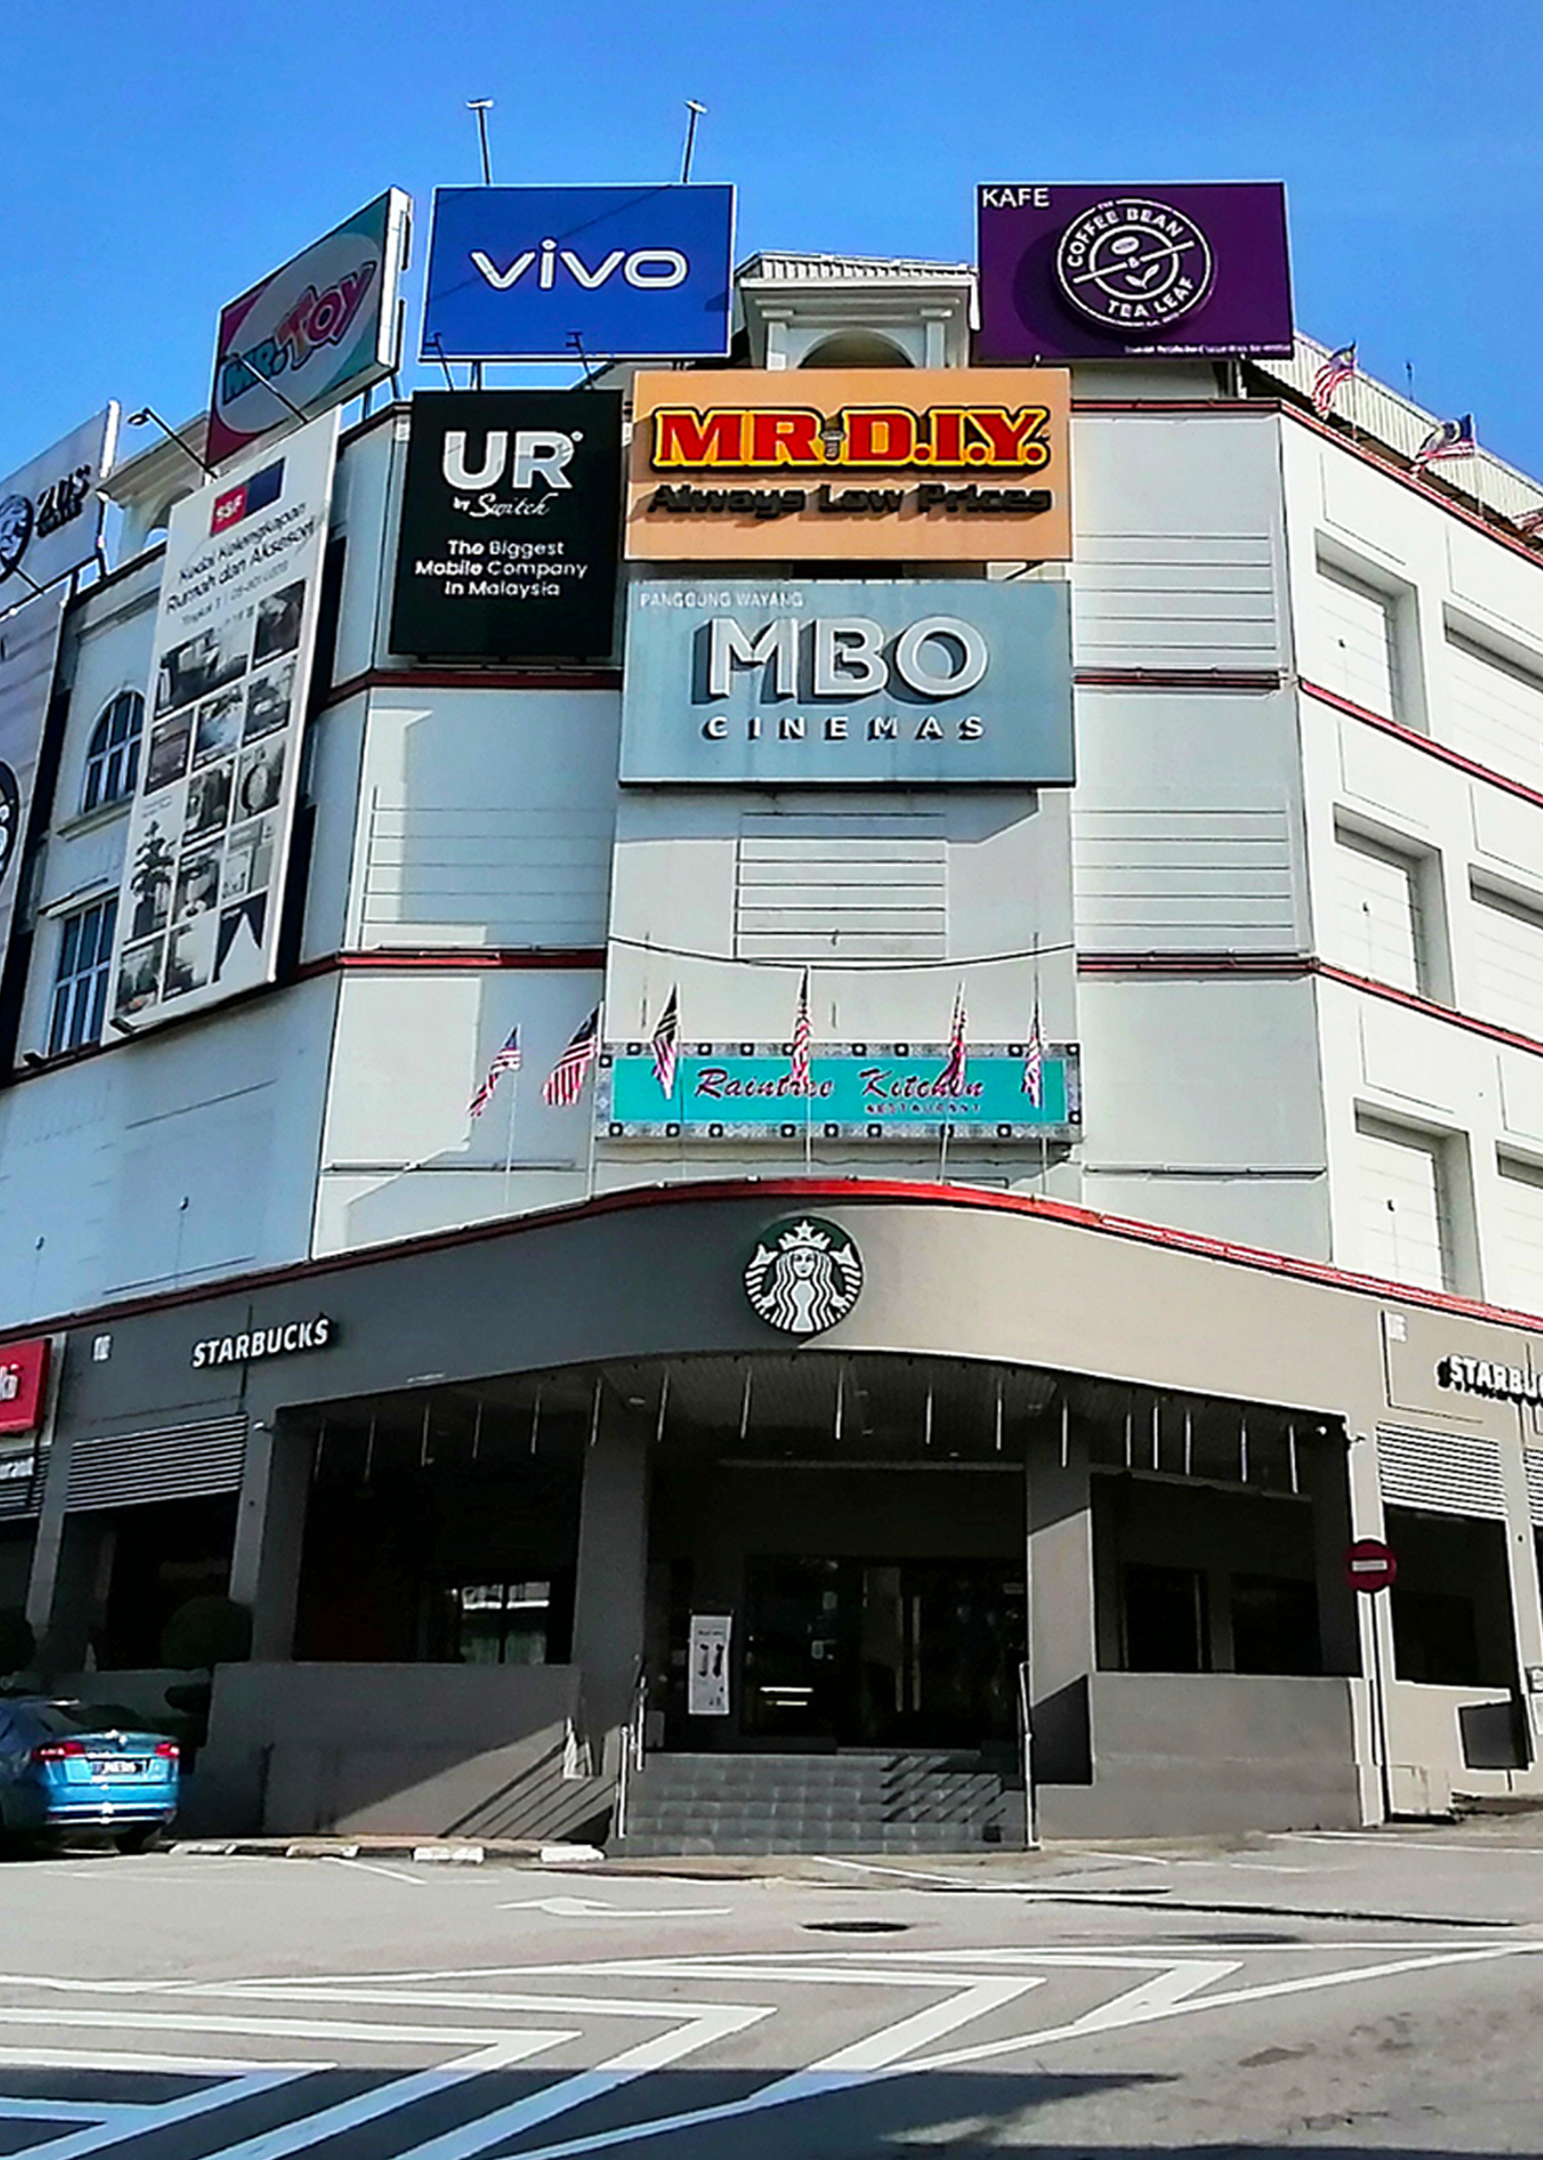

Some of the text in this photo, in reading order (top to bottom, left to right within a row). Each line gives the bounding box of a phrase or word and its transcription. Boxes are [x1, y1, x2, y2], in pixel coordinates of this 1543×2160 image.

[981, 187, 1050, 208] KAFE
[1067, 207, 1184, 268] COFFEE BEAN
[470, 238, 688, 289] vivo
[1107, 276, 1194, 318] TEA LEAF
[443, 431, 574, 489] UR
[469, 492, 559, 517] Switch
[648, 484, 1052, 519] Always Low Prices
[448, 539, 565, 559] The Biggest
[415, 560, 588, 579] Mobile Company
[468, 581, 560, 599] Malaysia
[640, 591, 803, 608] PANGGUNG WAYANG
[707, 615, 989, 698] MBO
[706, 716, 984, 739] CINEMAS
[192, 1318, 329, 1368] STARBUCKS
[1449, 1355, 1543, 1400] STARBU
